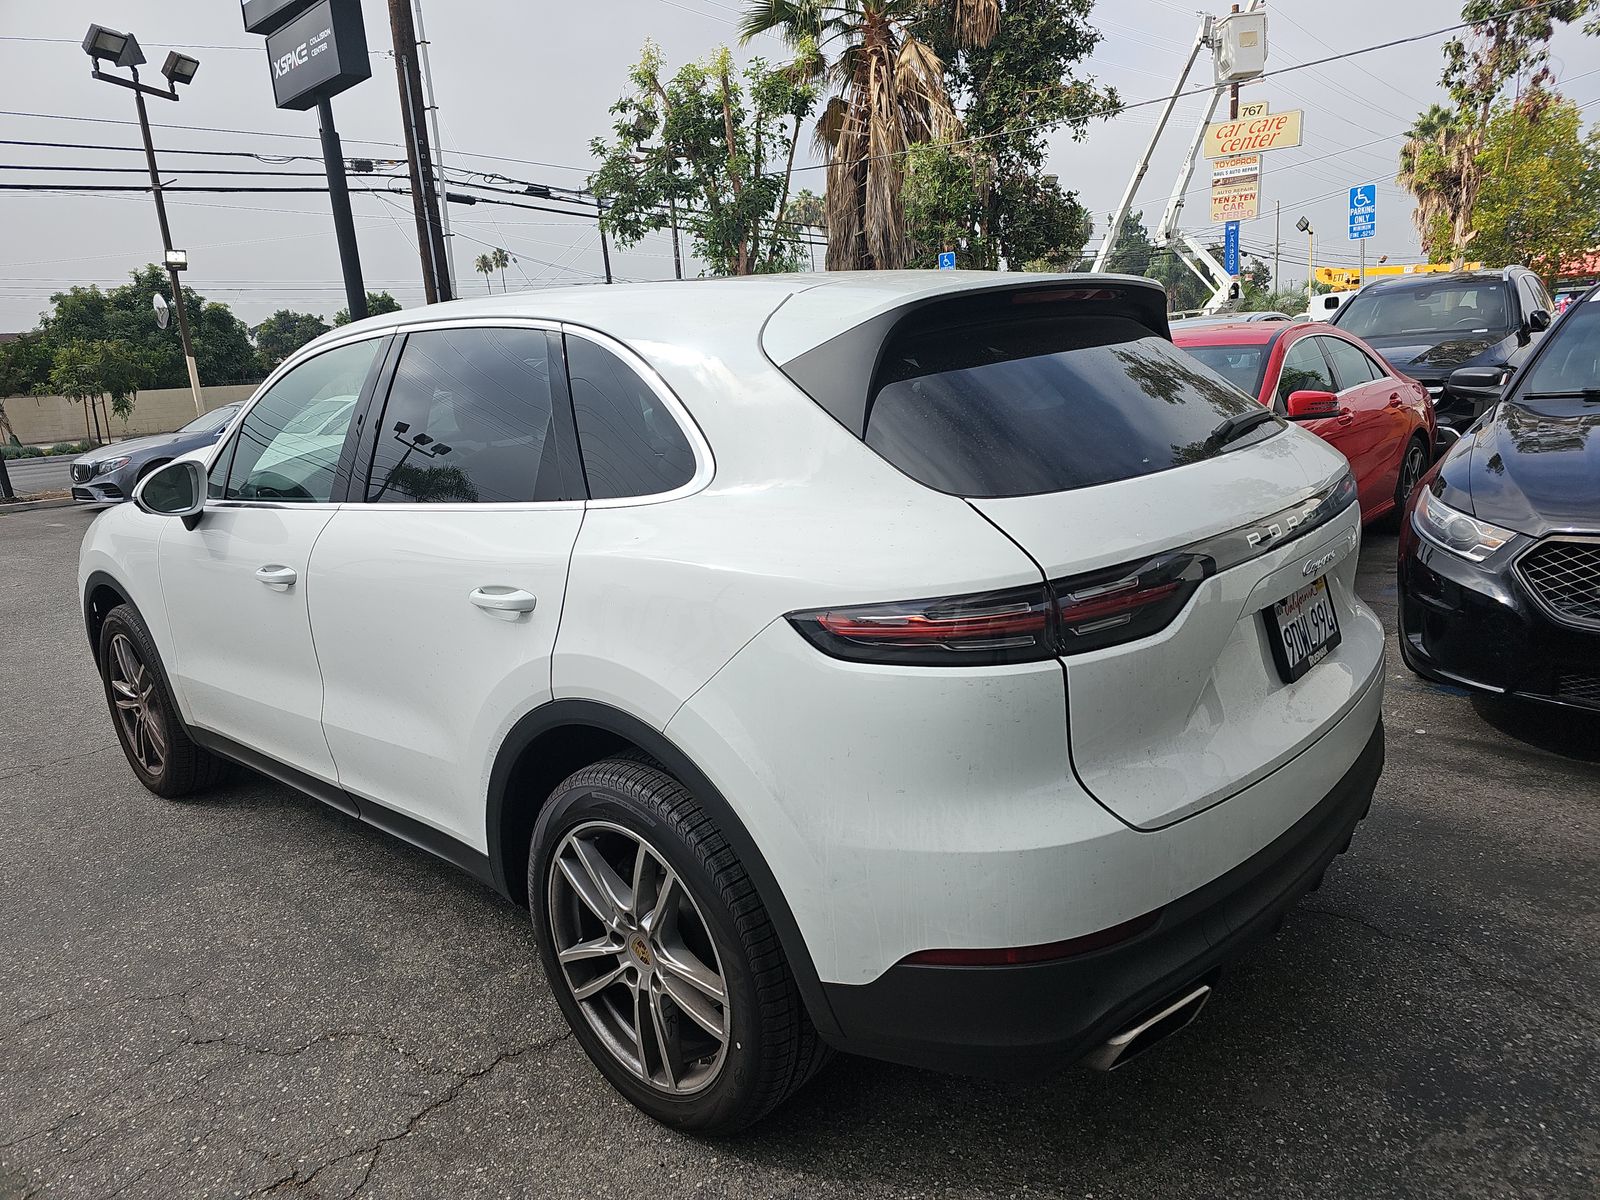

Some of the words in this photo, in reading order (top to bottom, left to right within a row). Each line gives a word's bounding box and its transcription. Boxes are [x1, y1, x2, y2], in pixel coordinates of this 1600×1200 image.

[310, 28, 331, 45] COLLISION
[310, 42, 328, 57] CENTER
[273, 42, 309, 79] XSPACE
[1242, 104, 1263, 117] 767
[1216, 122, 1246, 139] car
[1249, 115, 1288, 134] care
[1220, 132, 1281, 153] center
[1215, 156, 1257, 169] TOYOPROS
[1213, 196, 1230, 204] TEN
[1231, 195, 1237, 203] 2
[1239, 193, 1256, 201] TEN
[1223, 201, 1245, 211] CAR
[1350, 205, 1375, 216] PARKING
[1213, 209, 1254, 220] STEREO
[1354, 214, 1370, 224] ONLY
[1284, 586, 1318, 615] California
